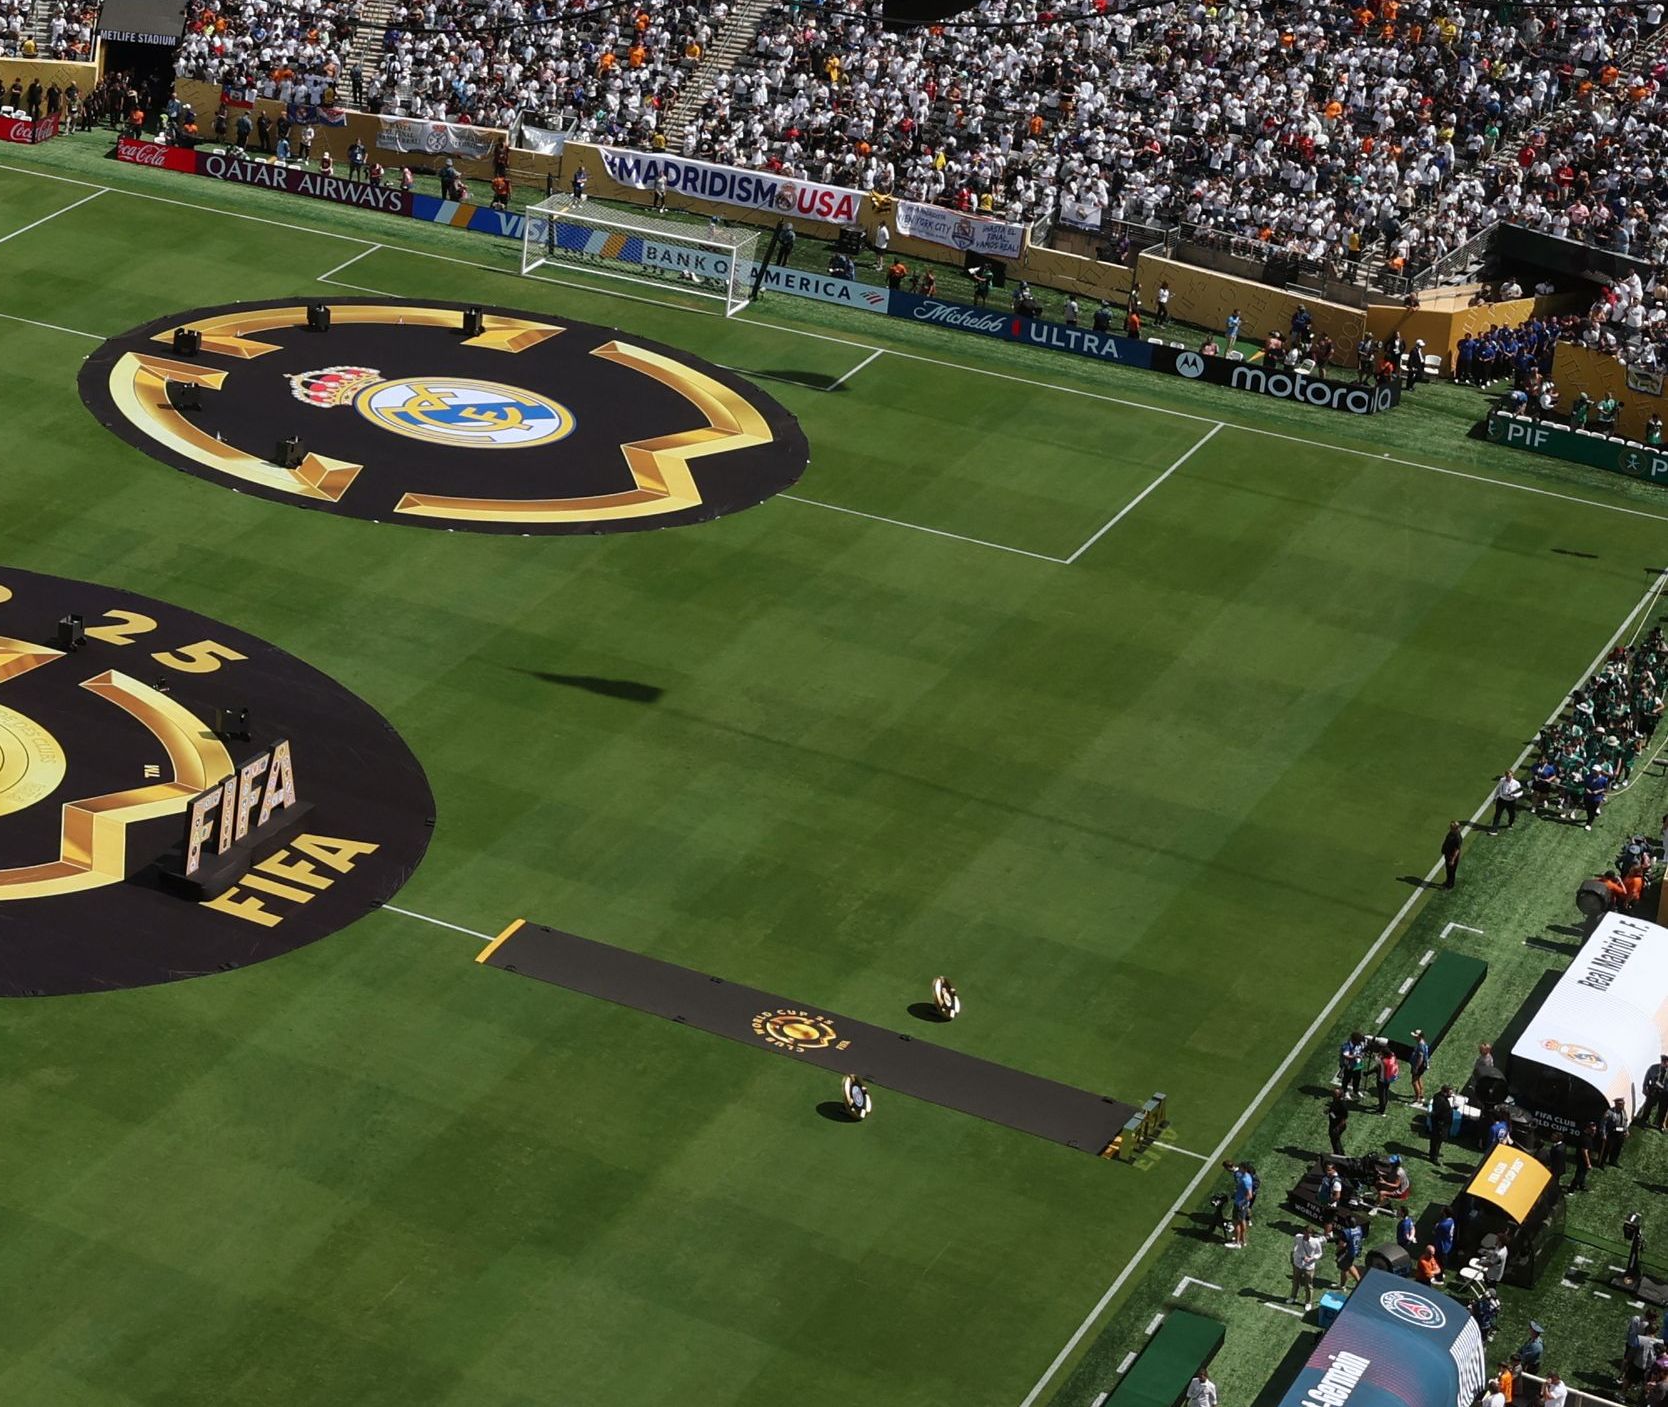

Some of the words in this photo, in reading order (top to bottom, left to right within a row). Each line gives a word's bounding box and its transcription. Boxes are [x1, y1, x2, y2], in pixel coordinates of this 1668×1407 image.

[100, 28, 138, 44] METLIFE
[138, 32, 177, 47] STADIUM
[206, 155, 289, 189] QATAR
[297, 174, 403, 212] AIRWAYS
[605, 152, 779, 208] #MADRIDISM
[797, 188, 853, 223] USA
[496, 210, 559, 248] VISA
[934, 222, 952, 235] CITY
[646, 245, 707, 272] BANK
[750, 265, 853, 301] AMERICA
[912, 298, 1007, 334] Michelob
[1030, 322, 1120, 359] ULTRA
[1231, 365, 1392, 414] motorola
[1507, 422, 1550, 448] PIF
[84, 608, 249, 676] 25
[186, 738, 297, 877] FIFA
[198, 832, 381, 928] FIFA
[1591, 939, 1637, 973] Madrid
[1576, 966, 1616, 992] Real
[752, 1010, 773, 1037] WORLD
[776, 1008, 810, 1019] CUP
[815, 1014, 835, 1027] 25
[764, 1035, 806, 1054] CLUB
[835, 1039, 853, 1051] FIFA
[1534, 1110, 1554, 1123] FIFA
[1554, 1114, 1576, 1128] CLUB
[1550, 1122, 1569, 1134] CUP
[1294, 1203, 1319, 1219] WORLD
[1307, 1201, 1321, 1213] FIFA
